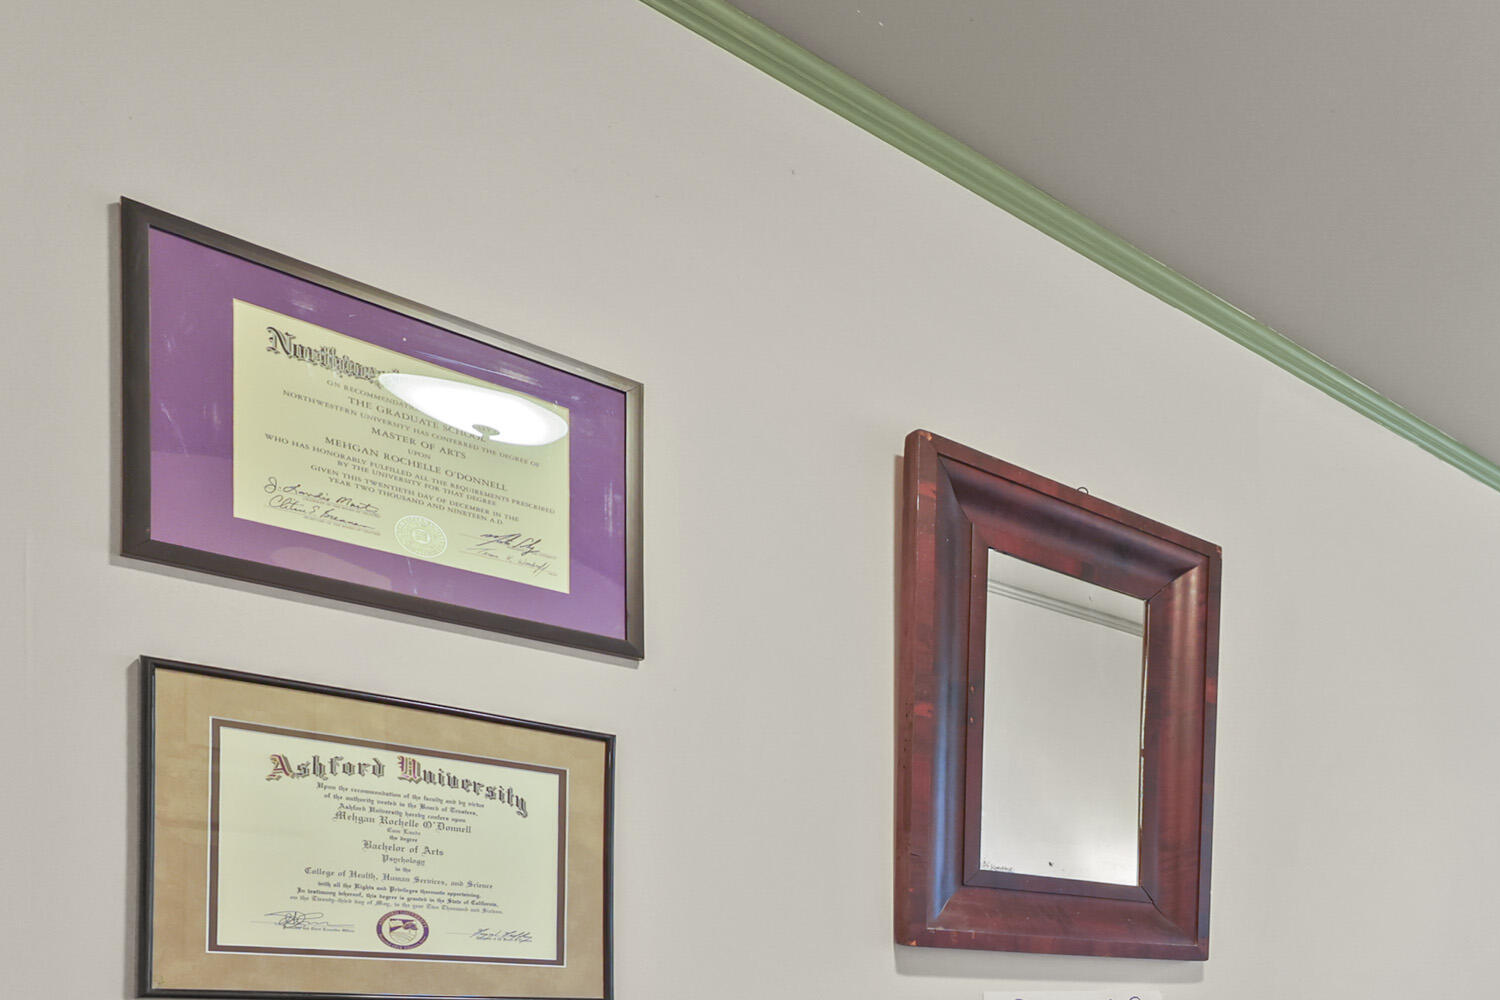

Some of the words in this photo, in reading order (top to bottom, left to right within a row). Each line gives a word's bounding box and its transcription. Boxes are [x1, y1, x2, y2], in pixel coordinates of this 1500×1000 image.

[282, 390, 358, 417] NORTHWESTERN
[360, 412, 410, 432] UNIVERSITY
[347, 395, 372, 410] THE
[376, 405, 439, 430] GRADUATE
[264, 433, 289, 445] WHO
[292, 440, 310, 450] HAS
[312, 446, 367, 465] HONORABLY
[371, 427, 417, 445] MASTER
[420, 441, 435, 450] OF
[439, 447, 466, 459] ARTS
[407, 449, 431, 460] UPON
[325, 436, 380, 457] MEHGAN
[383, 452, 441, 474] ROCHELLE
[445, 465, 507, 491] O'DONNELL
[310, 464, 339, 476] GIVEN
[342, 473, 362, 483] THIS
[417, 490, 433, 501] DAY
[328, 476, 352, 488] YEAR
[355, 483, 375, 493] TWO
[378, 489, 425, 506] THOUSAND
[352, 464, 369, 473] THE
[372, 469, 421, 488] UNIVERSITY
[424, 483, 440, 492] FOR
[442, 487, 464, 499] THAT
[265, 753, 387, 781] Ashford
[397, 755, 528, 819] University
[332, 810, 375, 824] Mehgan
[378, 815, 419, 828] Rochelle
[422, 820, 472, 833] O'Donnell
[362, 840, 406, 853] Bachelor
[409, 846, 419, 854] of
[422, 846, 444, 856] Arts
[381, 854, 426, 866] Psychology
[304, 866, 335, 878] College
[382, 873, 410, 882] Human
